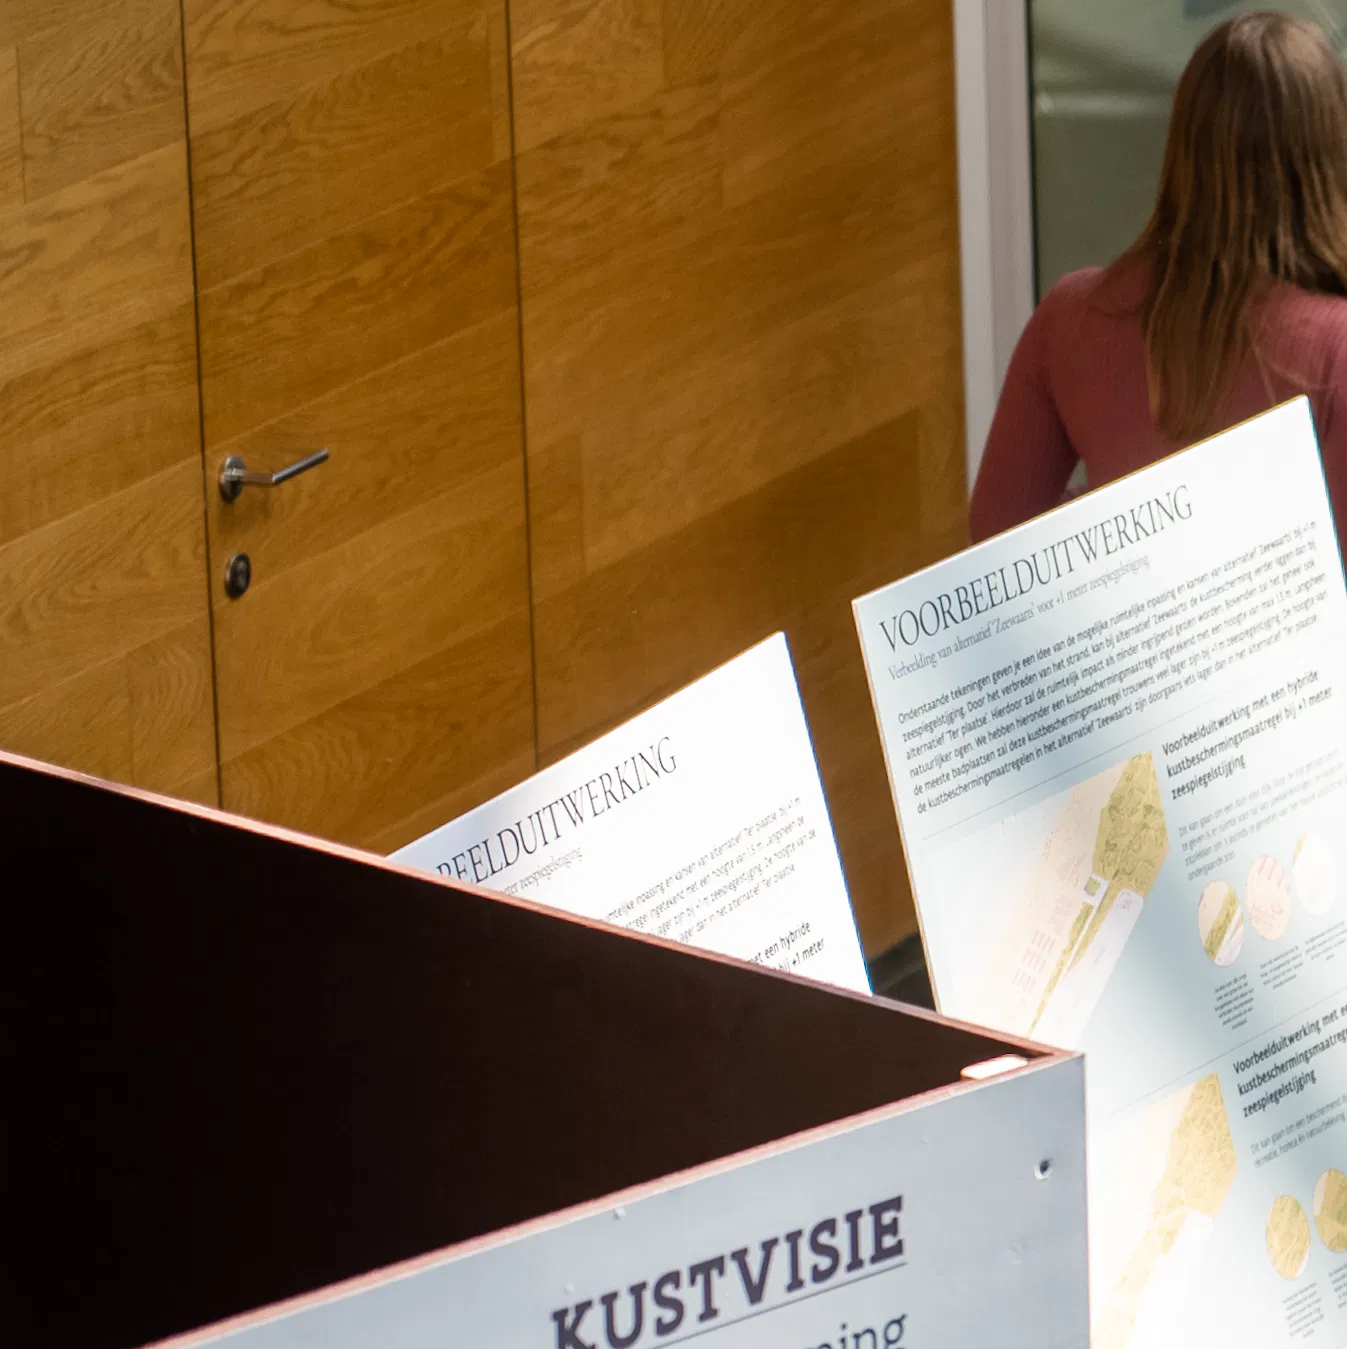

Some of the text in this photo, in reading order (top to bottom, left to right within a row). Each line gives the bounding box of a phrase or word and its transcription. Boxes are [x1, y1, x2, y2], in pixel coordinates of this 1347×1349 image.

[881, 484, 1193, 653] VOORBEELDUITWERKING
[897, 692, 950, 725] Onderstaande
[949, 674, 991, 701] tekeningen
[991, 664, 1012, 685] geven
[1011, 660, 1020, 675] je
[1021, 653, 1035, 667] een
[1035, 646, 1051, 660] idee
[1052, 639, 1066, 653] van
[1065, 633, 1076, 646] de
[937, 645, 952, 659] van
[966, 696, 986, 712] Door
[985, 686, 1000, 703] het
[1000, 671, 1038, 696] verbreden
[1038, 665, 1052, 678] van
[1051, 655, 1065, 672] het
[1090, 640, 1104, 654] kan
[905, 731, 946, 761] alternatief
[989, 698, 1023, 721] Hierdoor
[1023, 689, 1035, 705] zal
[1034, 686, 1046, 699] de
[974, 733, 987, 748] We
[987, 721, 1015, 742] hebben
[1014, 704, 1051, 728] hieronder
[1051, 697, 1065, 711] een
[1161, 668, 1320, 757] Voorbeelduitwerking met een hybride
[1165, 707, 1282, 778] kustbeschermingsmaatregel
[1283, 701, 1297, 719] bij
[1307, 685, 1333, 706] meter
[912, 783, 923, 797] de
[924, 770, 951, 792] meeste
[950, 750, 996, 779] badplaatsen
[996, 740, 1008, 757] zal
[1007, 735, 1026, 751] deze
[915, 800, 927, 814] de
[926, 750, 1034, 809] kustbeschermingsmaatregelen
[1034, 745, 1043, 757] in
[1042, 736, 1056, 753] het
[1057, 718, 1095, 746] alternatief
[1170, 754, 1247, 800] zeespiegelstijging
[764, 922, 811, 959] een hybride
[801, 938, 825, 961] meter
[1232, 1019, 1322, 1075] Voorbeelduitwerking
[1321, 1006, 1338, 1027] met
[1242, 1069, 1317, 1117] zeespiegelstijging
